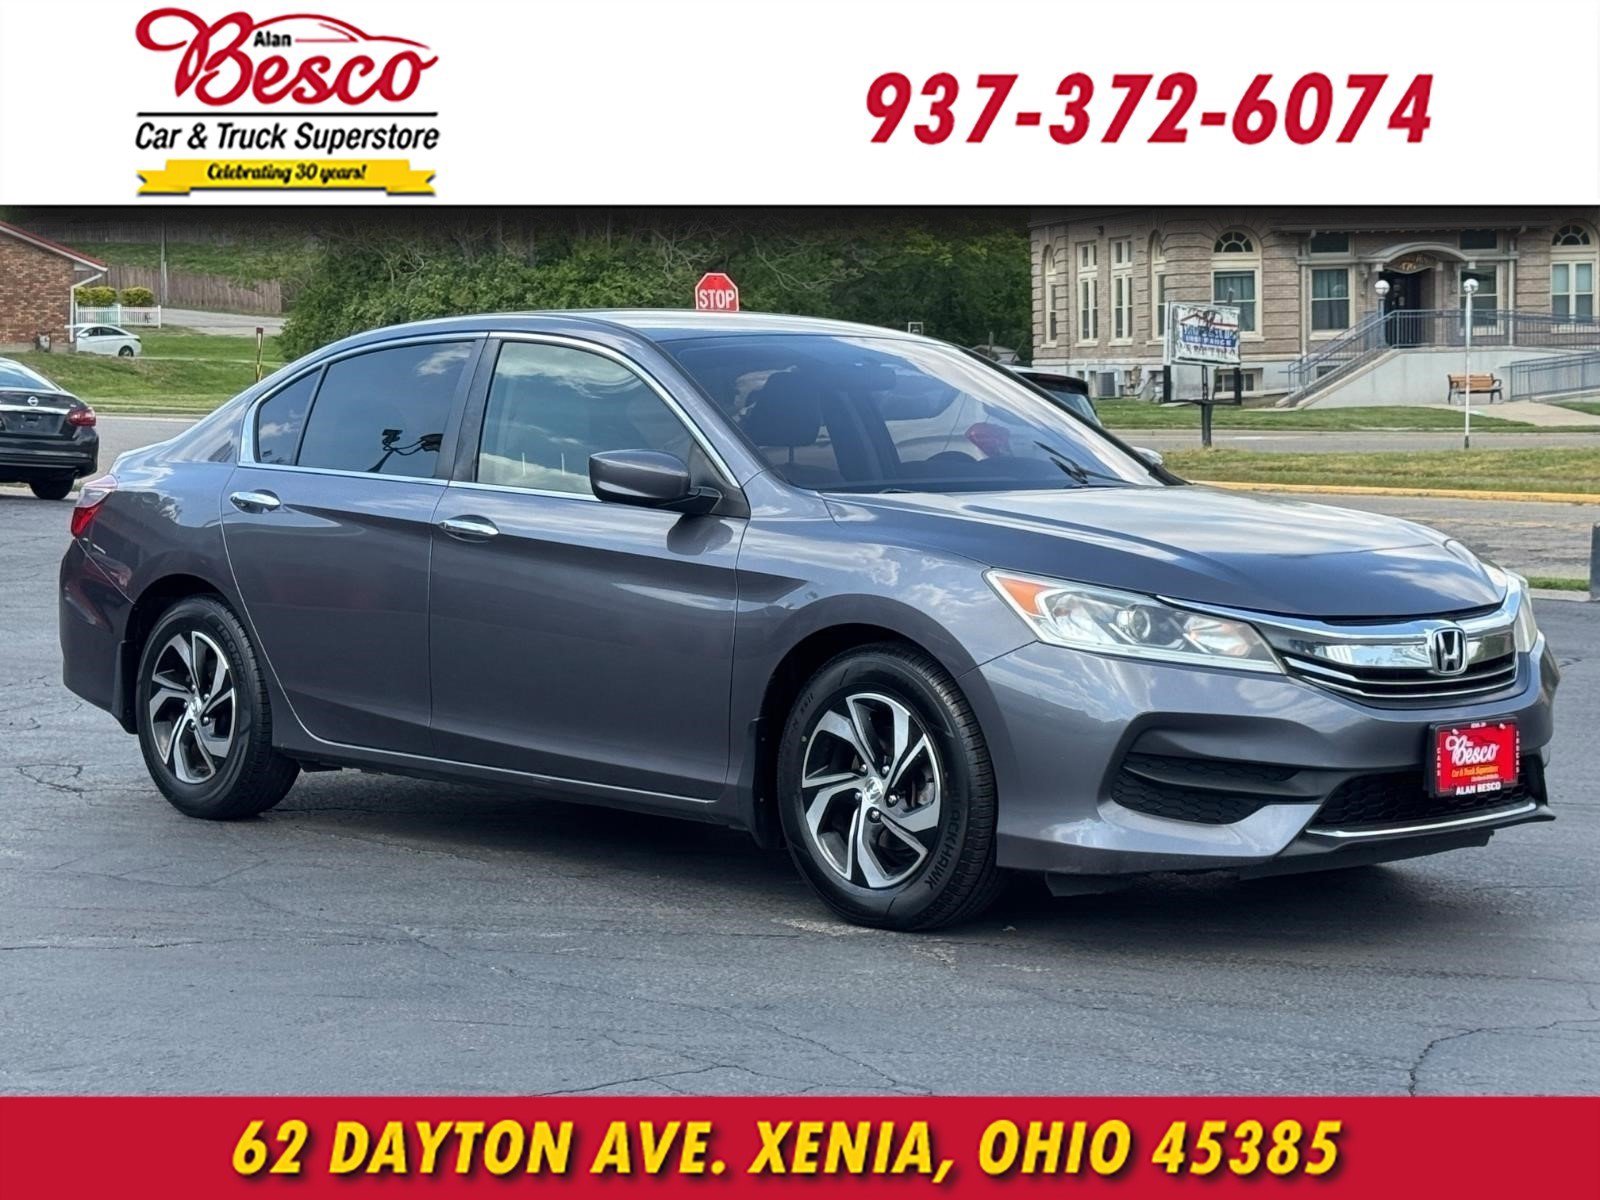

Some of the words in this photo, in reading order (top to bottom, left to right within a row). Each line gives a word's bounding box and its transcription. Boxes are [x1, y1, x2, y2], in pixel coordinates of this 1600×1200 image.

[699, 289, 735, 309] STOP
[1445, 735, 1499, 766] Besco
[1456, 785, 1476, 795] ALAN
[1477, 782, 1501, 792] BESCO
